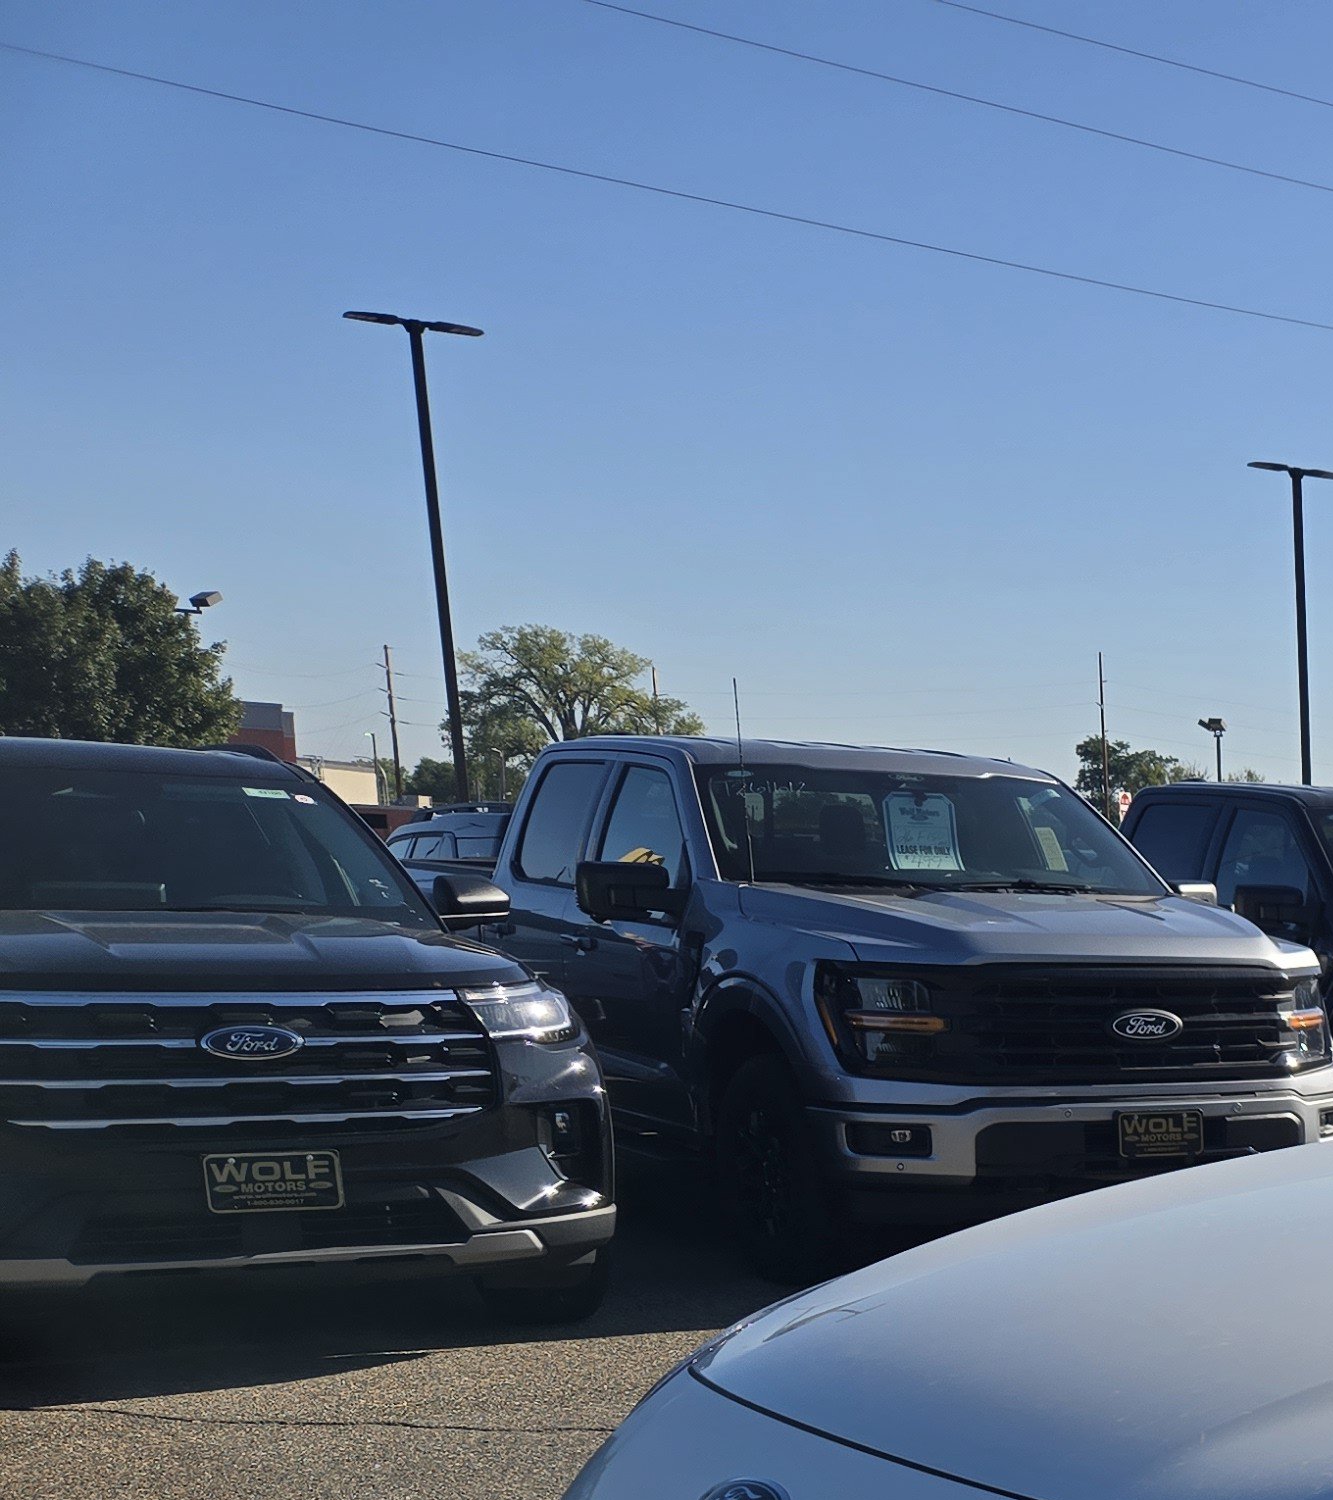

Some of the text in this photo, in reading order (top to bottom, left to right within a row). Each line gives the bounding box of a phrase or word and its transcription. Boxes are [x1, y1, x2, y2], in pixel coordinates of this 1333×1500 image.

[896, 845, 918, 854] LEASE
[1125, 1016, 1167, 1035] Ford
[225, 1032, 279, 1052] Ford
[1123, 1116, 1197, 1134] WOLF
[1140, 1133, 1182, 1142] MOTORS
[210, 1160, 330, 1183] WOLF
[240, 1181, 307, 1193] MOTORS
